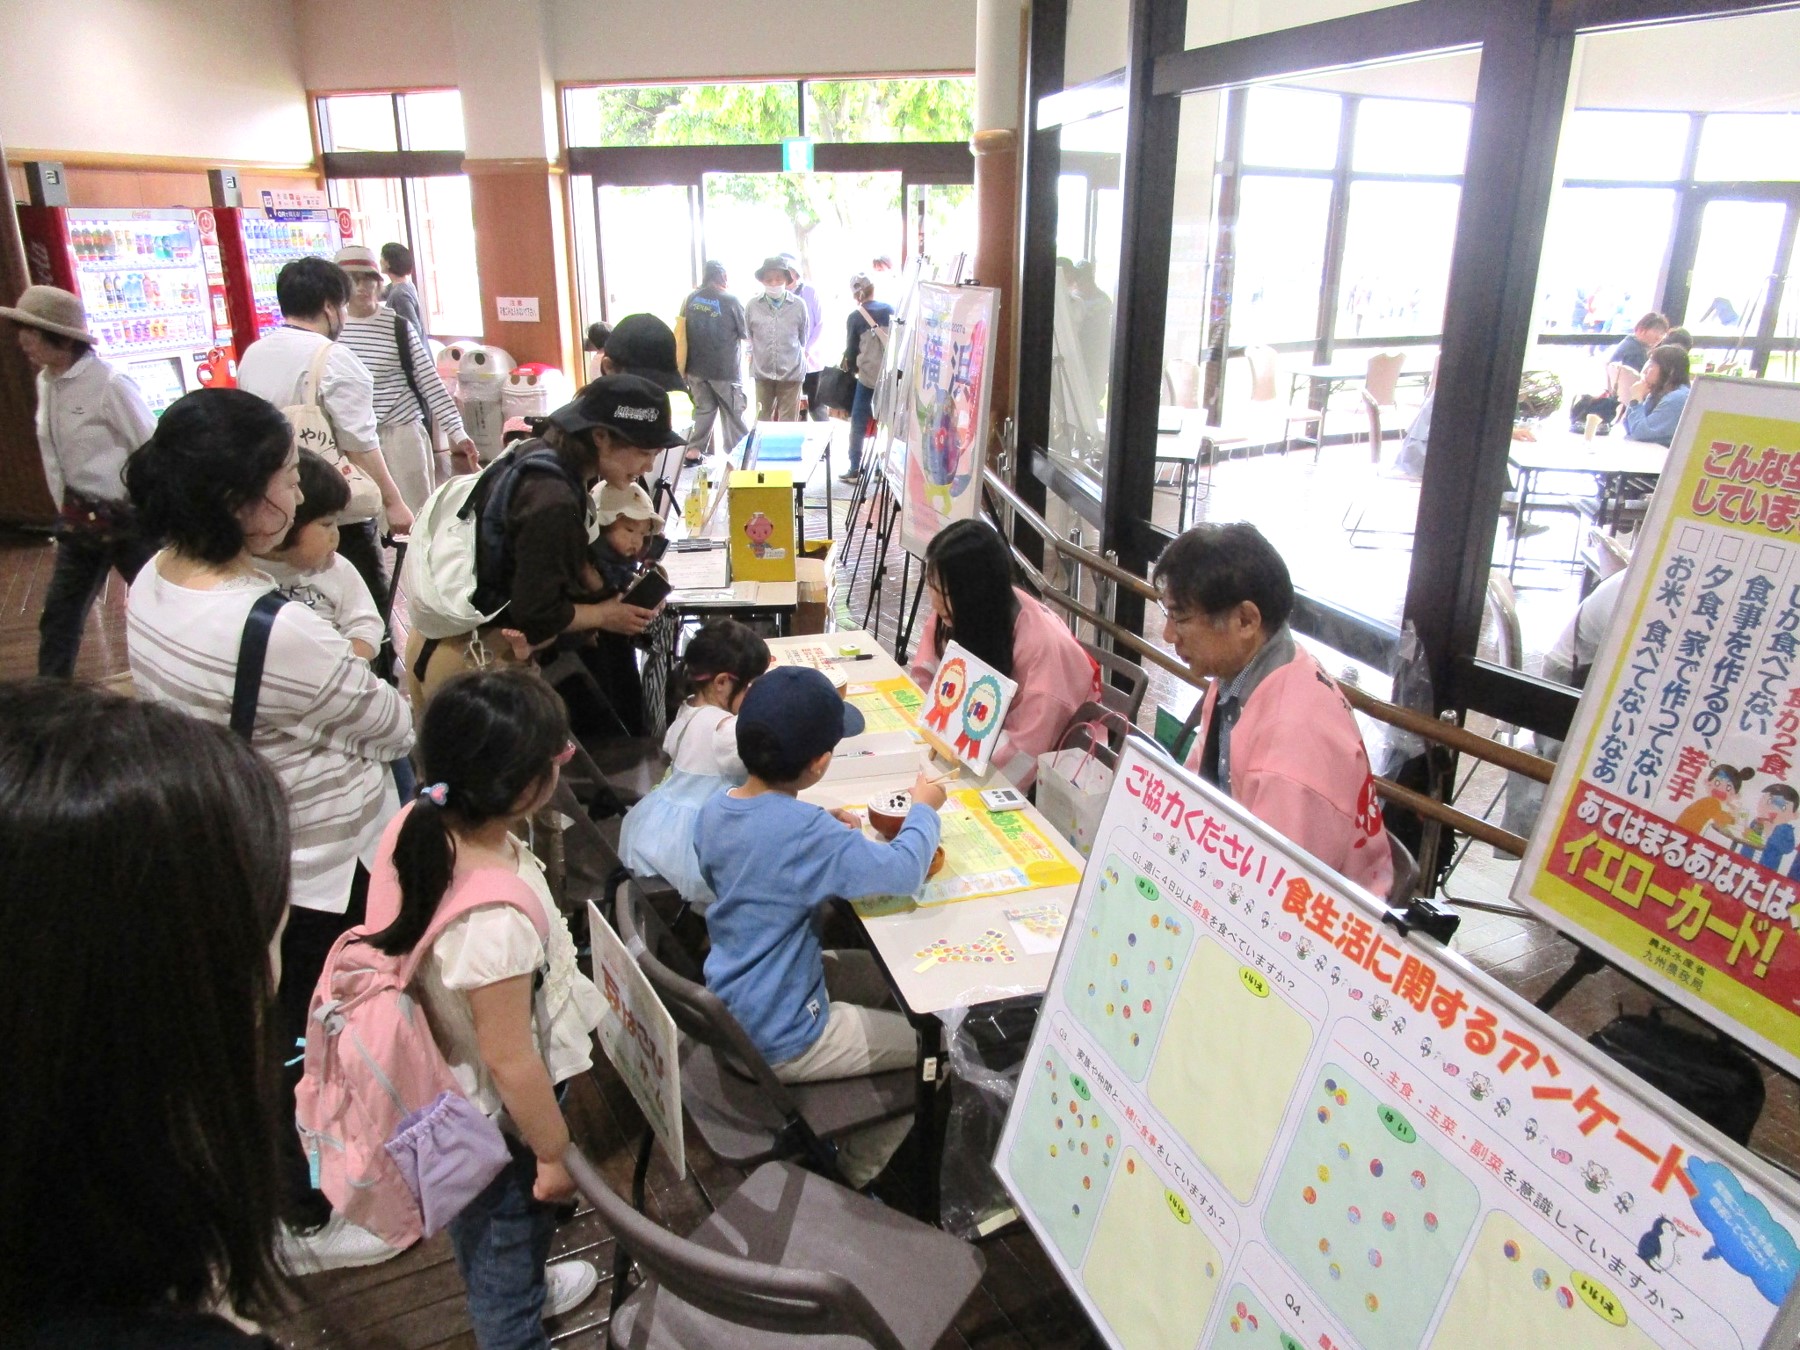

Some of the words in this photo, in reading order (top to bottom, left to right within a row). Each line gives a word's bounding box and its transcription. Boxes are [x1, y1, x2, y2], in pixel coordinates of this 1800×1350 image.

[1691, 477, 1800, 534] していま
[1592, 555, 1695, 784] お米、食べてないなあ
[1627, 565, 1733, 799] 夕食、家で作ってない
[1577, 790, 1796, 921] あてはまるあなたは
[1384, 1110, 1408, 1136] はい
[1580, 1279, 1615, 1316] いいえ
